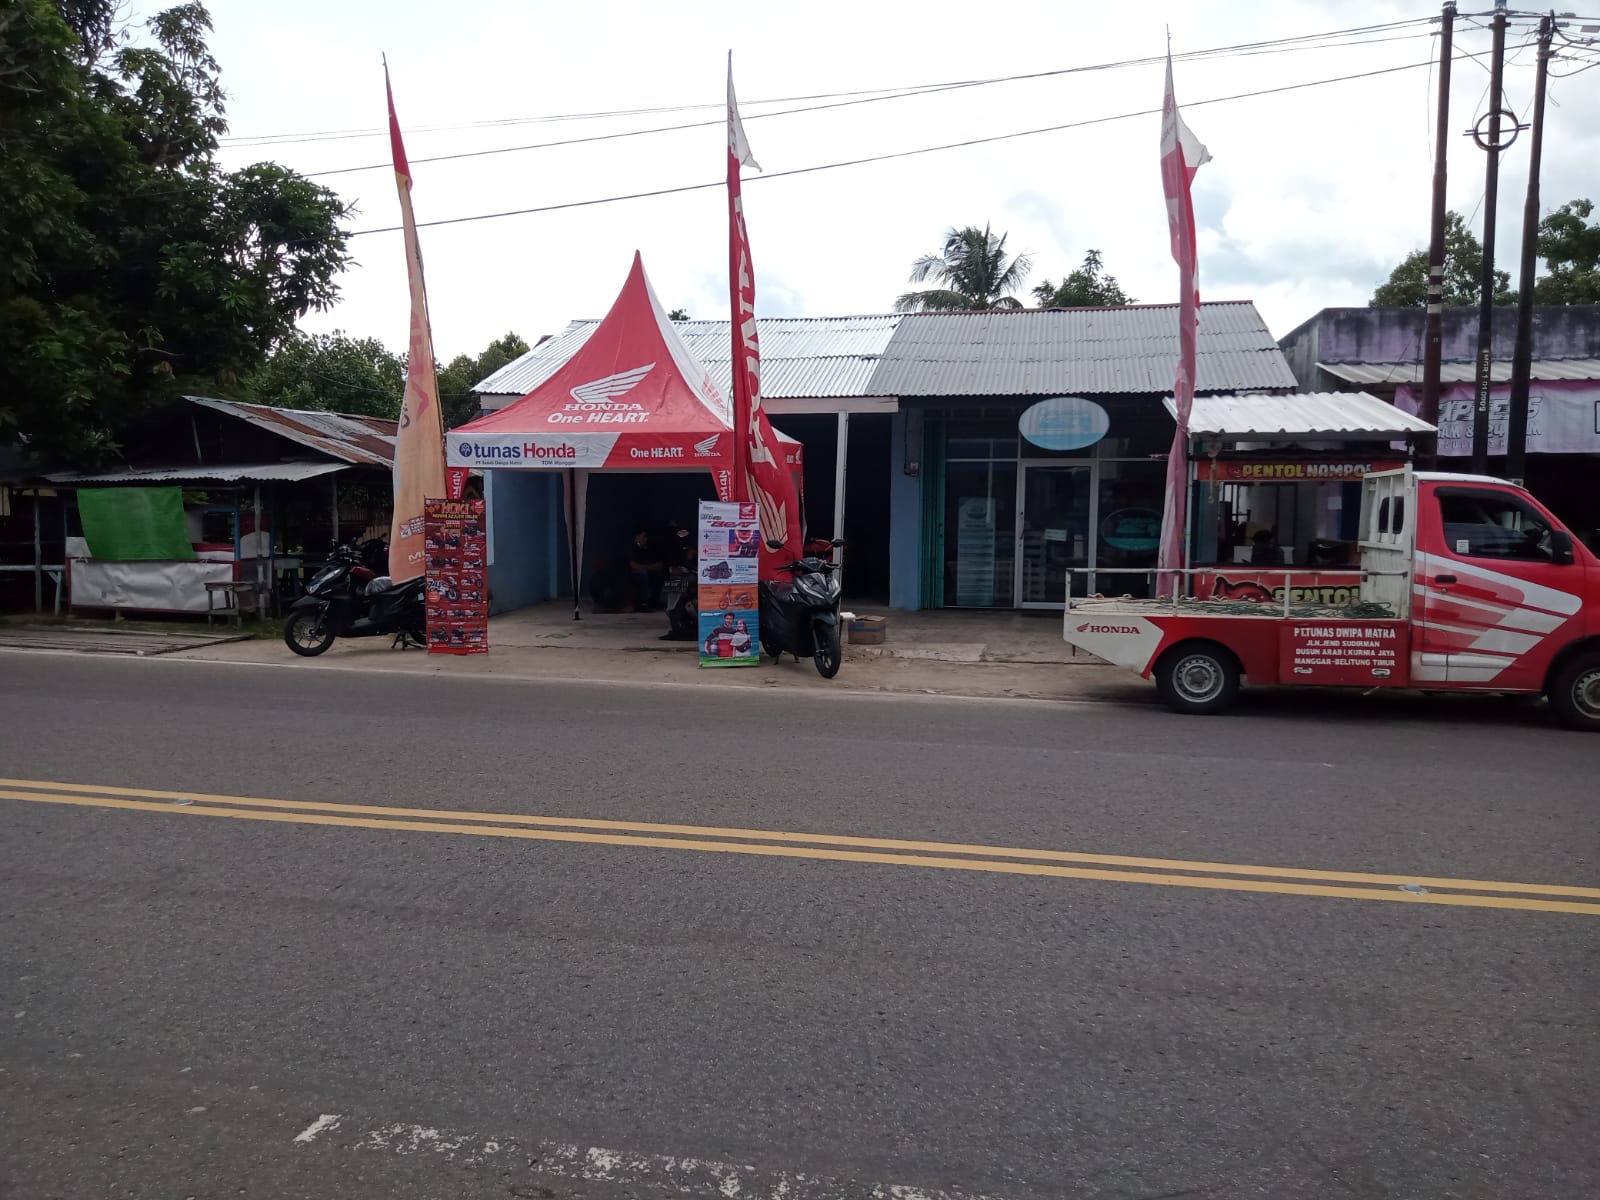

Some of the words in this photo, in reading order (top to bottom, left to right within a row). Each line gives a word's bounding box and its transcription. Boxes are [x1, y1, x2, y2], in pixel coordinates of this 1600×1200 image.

[563, 403, 644, 411] HONDA
[547, 412, 583, 424] One
[474, 443, 521, 458] tunas
[523, 443, 576, 458] Honda
[630, 447, 649, 458] One
[1242, 464, 1305, 479] PENTOL
[1090, 625, 1141, 635] HONDA
[1336, 628, 1363, 638] DWIPA
[1365, 628, 1396, 638] MATRA
[1342, 640, 1380, 648] SUDIRMAN
[1296, 648, 1320, 656] DUSUN
[1373, 659, 1396, 667] TIMUR
